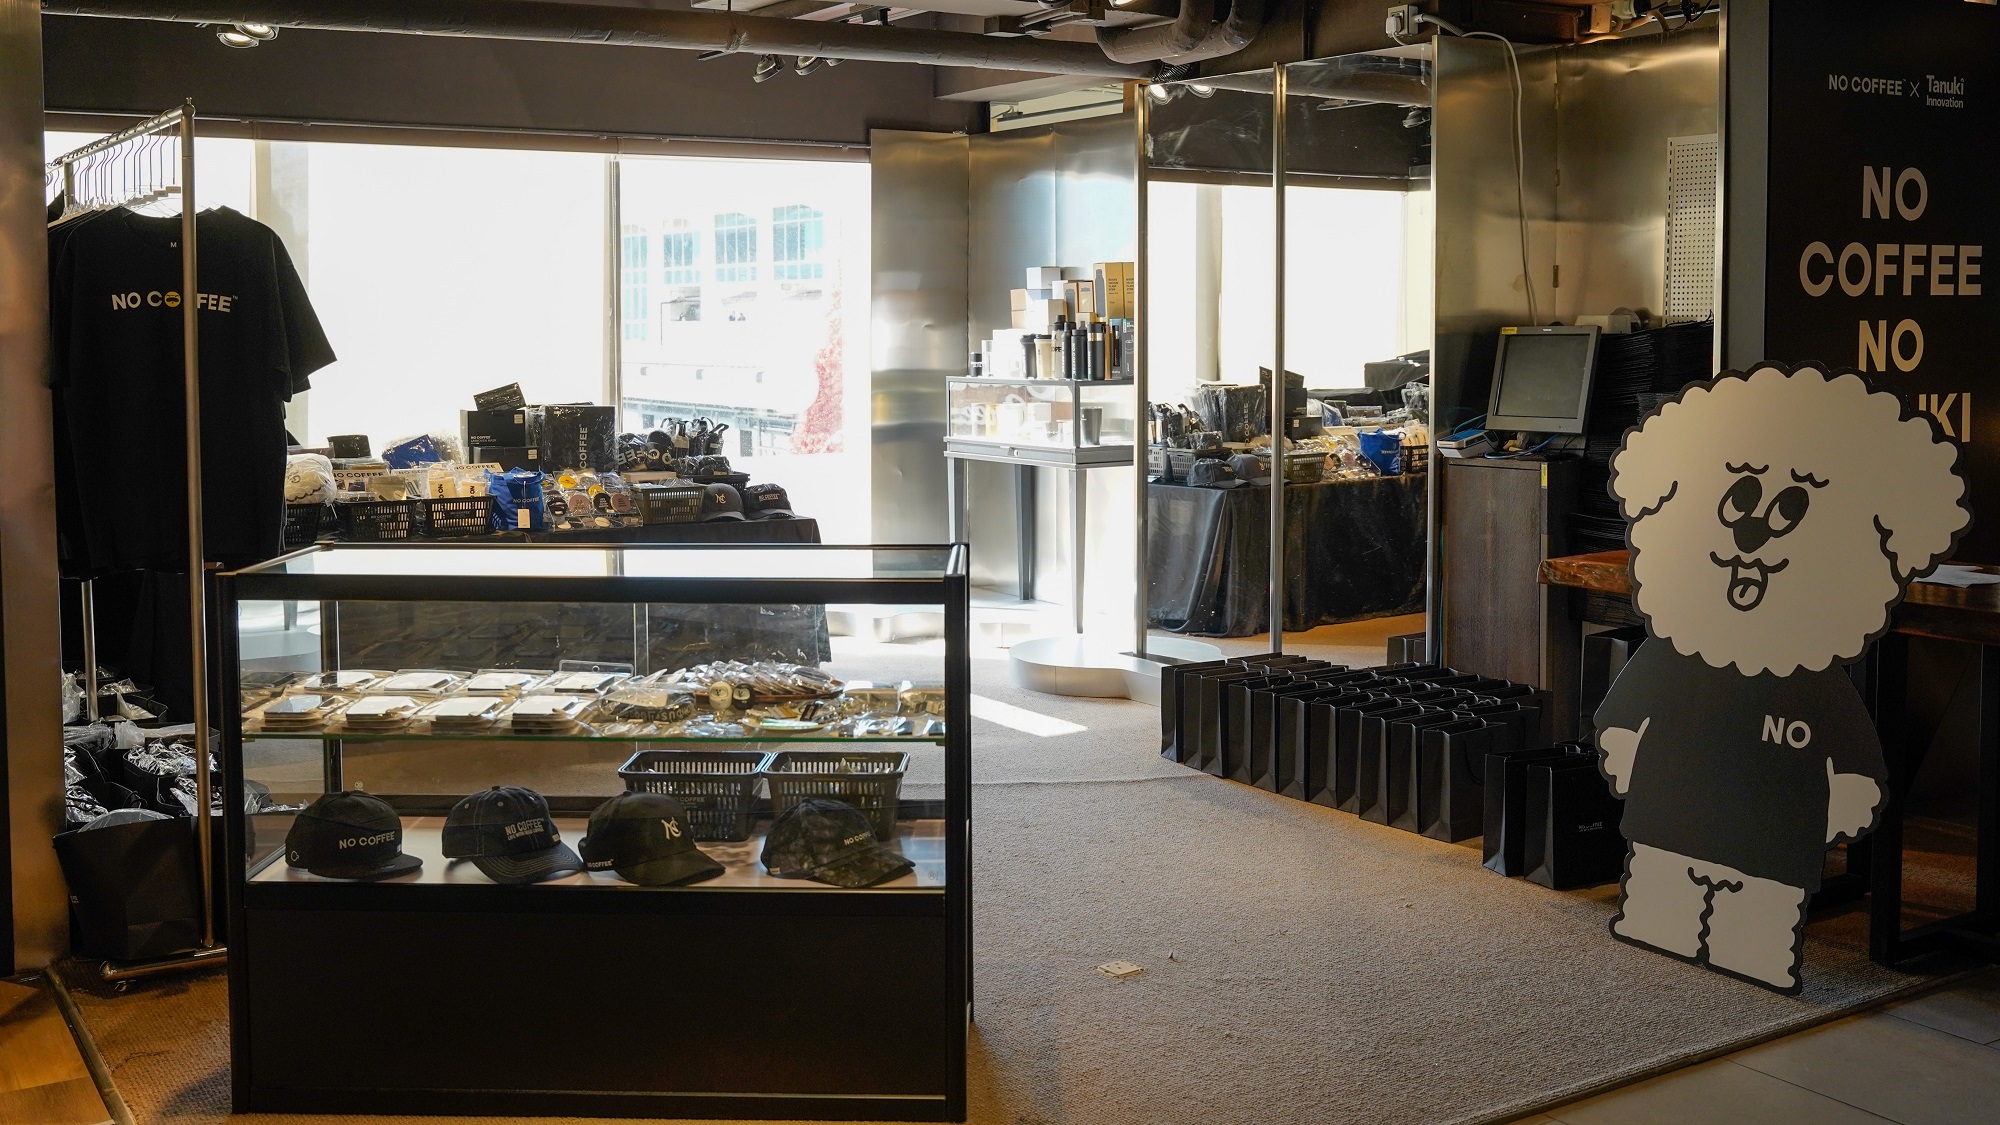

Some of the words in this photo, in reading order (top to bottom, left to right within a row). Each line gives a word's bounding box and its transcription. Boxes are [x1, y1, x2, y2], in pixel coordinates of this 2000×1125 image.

[1828, 74, 1848, 92] NO
[1851, 76, 1903, 96] COFFEE
[1926, 95, 1964, 109] Innovation
[1862, 165, 1928, 221] NO
[1799, 241, 1983, 297] COFFEE
[111, 292, 142, 310] NO
[1858, 318, 1924, 372] NO
[579, 427, 588, 469] COFFEE
[1761, 714, 1812, 749] NO
[338, 838, 357, 850] NO
[358, 832, 395, 847] COFFEE
[504, 824, 517, 836] NO
[843, 837, 855, 846] NO
